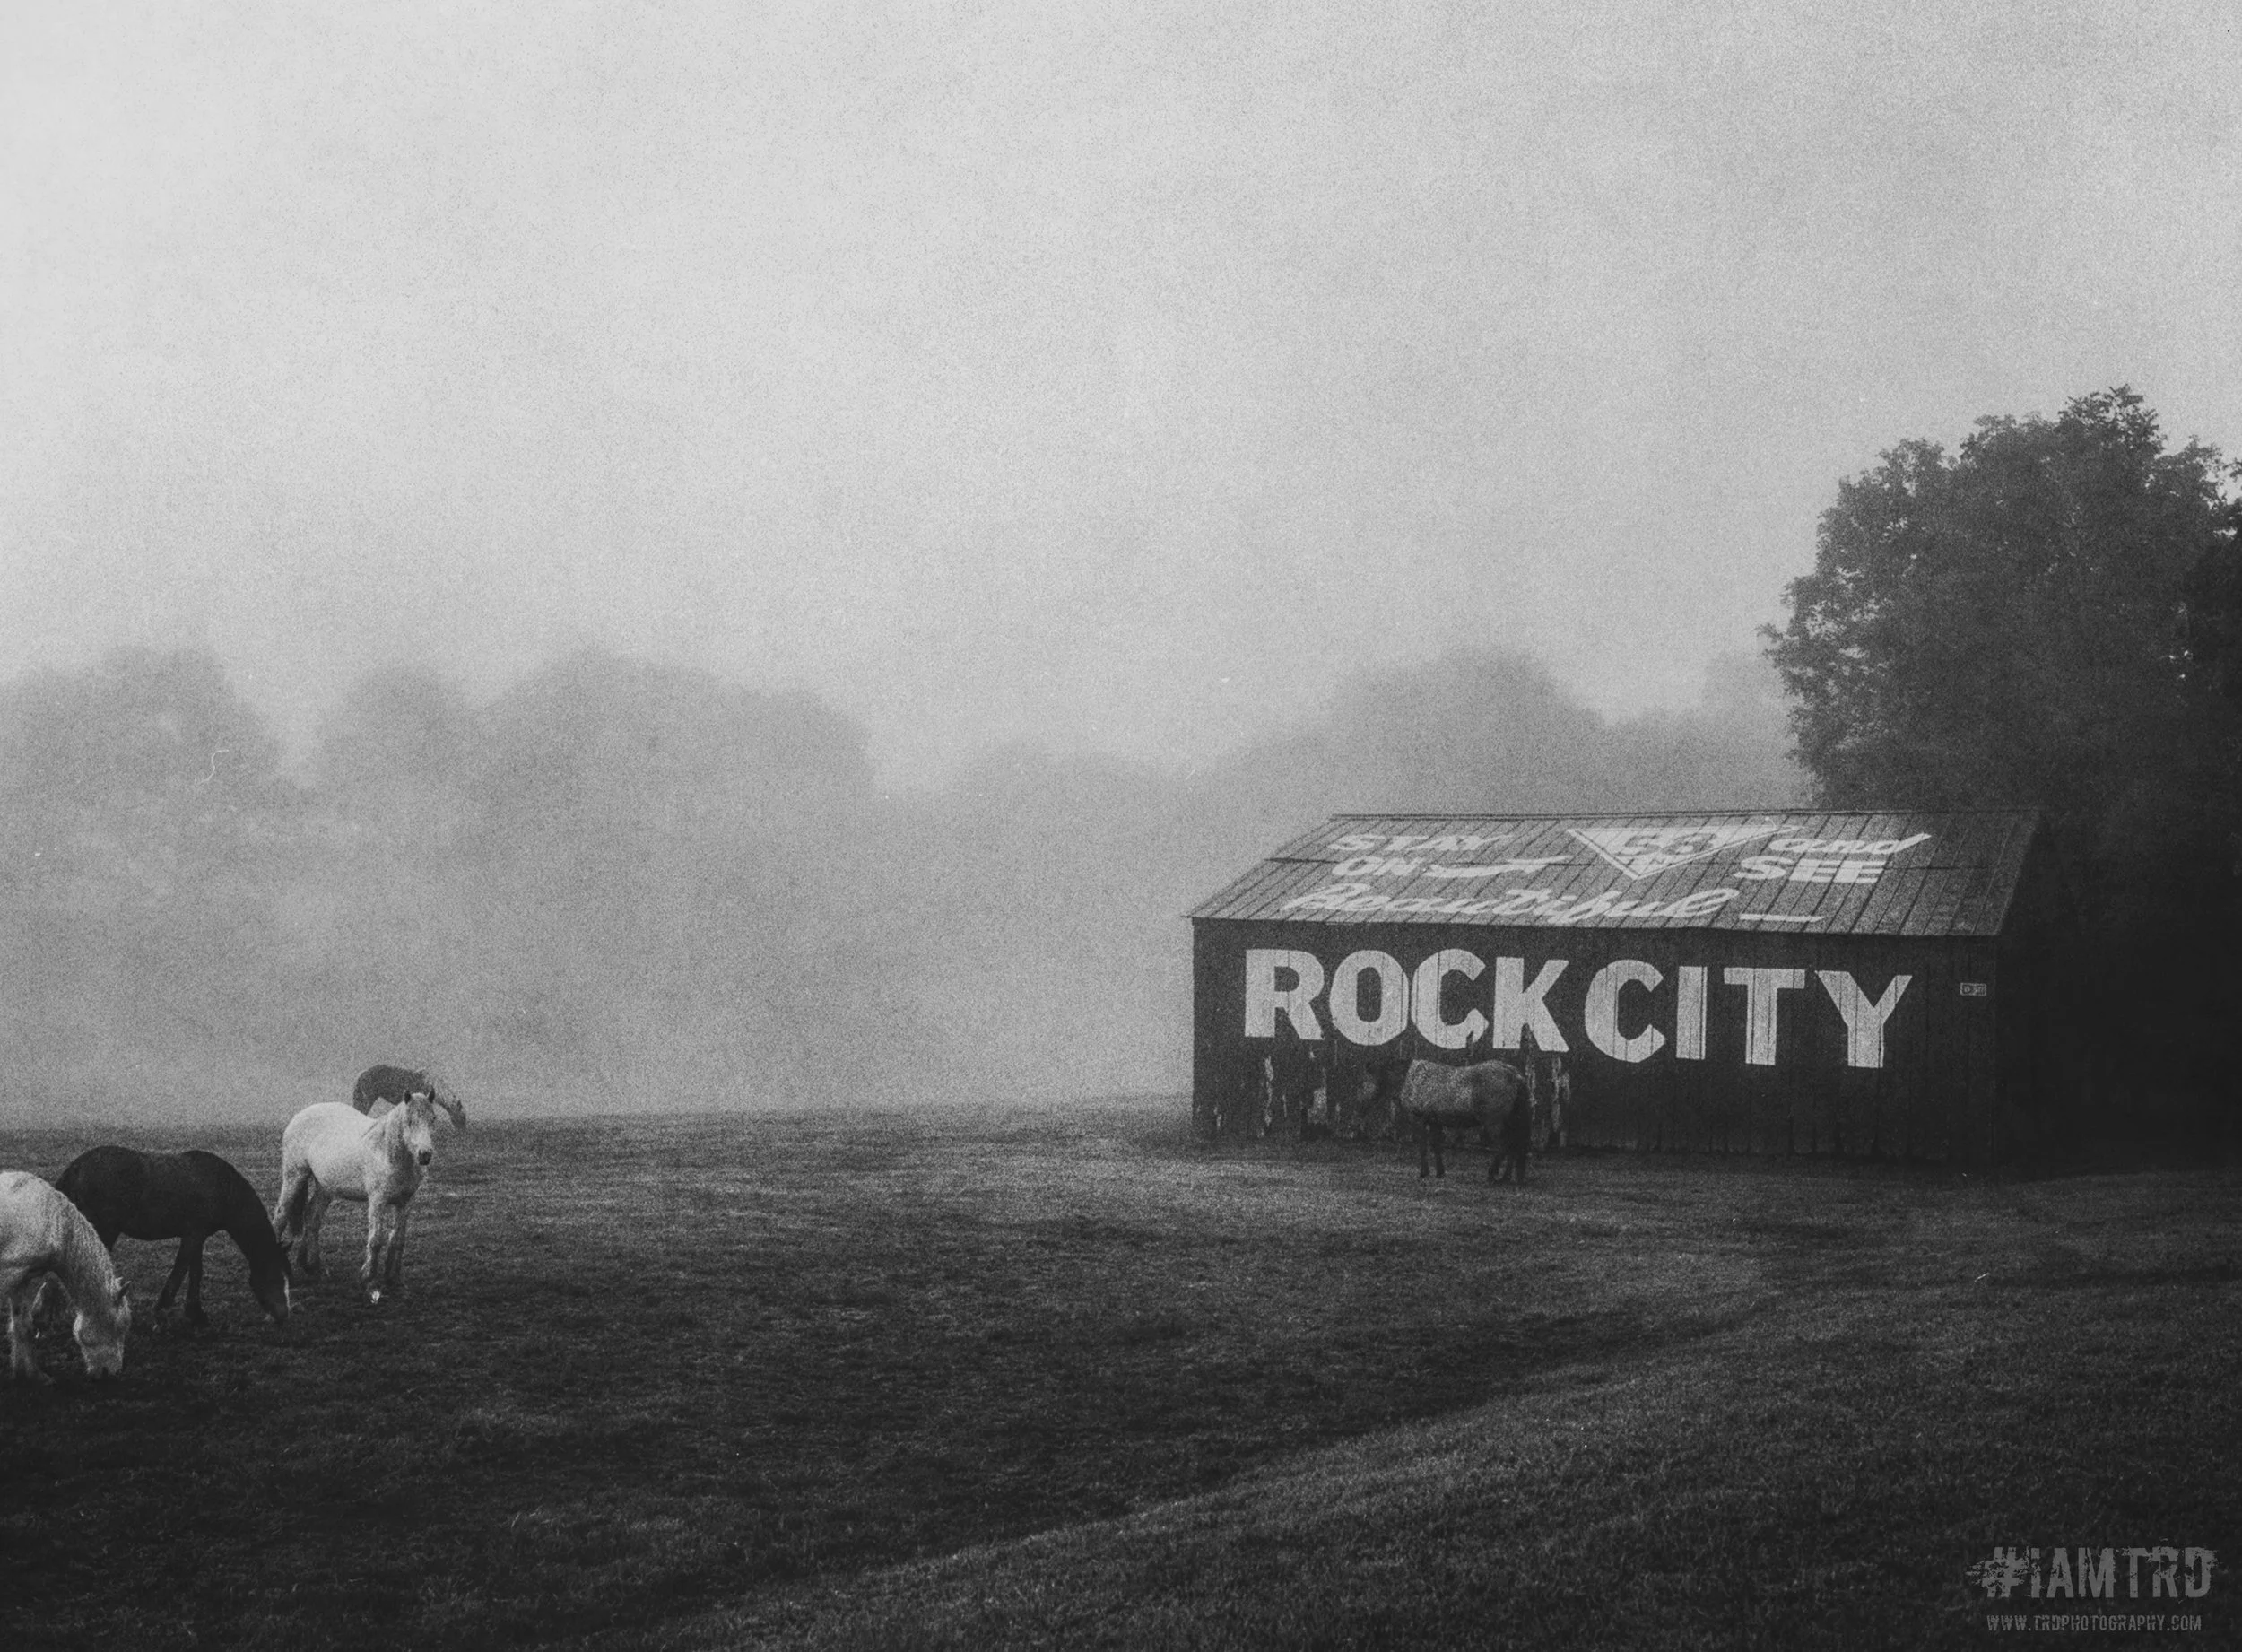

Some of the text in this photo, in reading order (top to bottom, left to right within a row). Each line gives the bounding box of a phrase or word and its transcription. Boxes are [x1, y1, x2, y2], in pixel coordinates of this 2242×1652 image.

[1327, 834, 1512, 851] STAY
[1768, 832, 1932, 855] and
[1332, 856, 1425, 876] ON
[1734, 856, 1887, 883] SEE
[1279, 883, 1740, 925] Beautiful
[1245, 948, 1912, 1069] ROCK CITY
